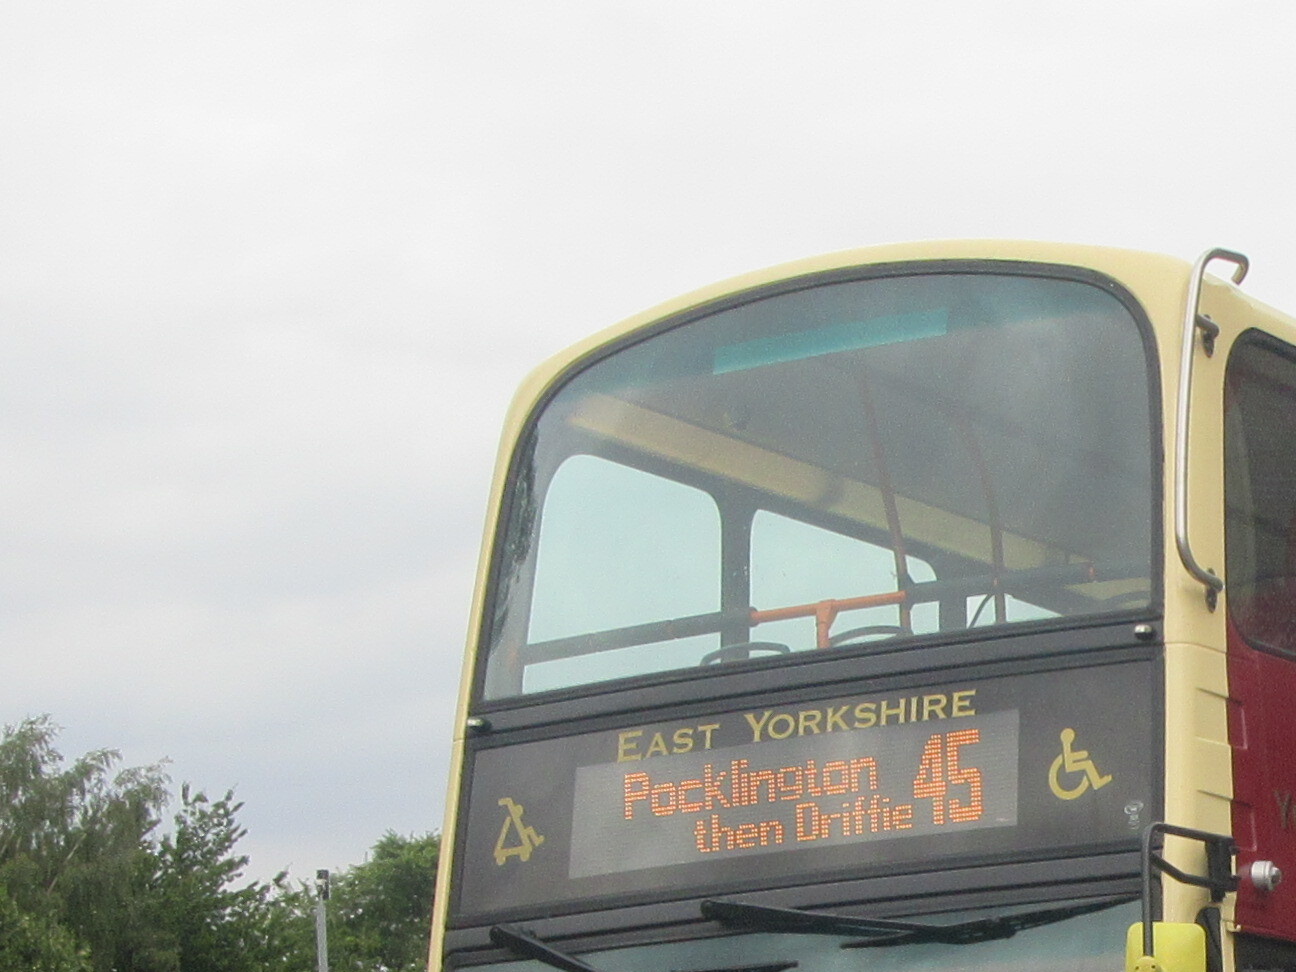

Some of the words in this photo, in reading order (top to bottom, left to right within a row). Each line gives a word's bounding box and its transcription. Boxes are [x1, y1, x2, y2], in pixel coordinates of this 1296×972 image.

[617, 723, 720, 763] EAST
[744, 689, 977, 742] YORKSHIRE
[624, 757, 878, 819] Pocklington
[913, 728, 983, 825] 45
[694, 812, 783, 852] then
